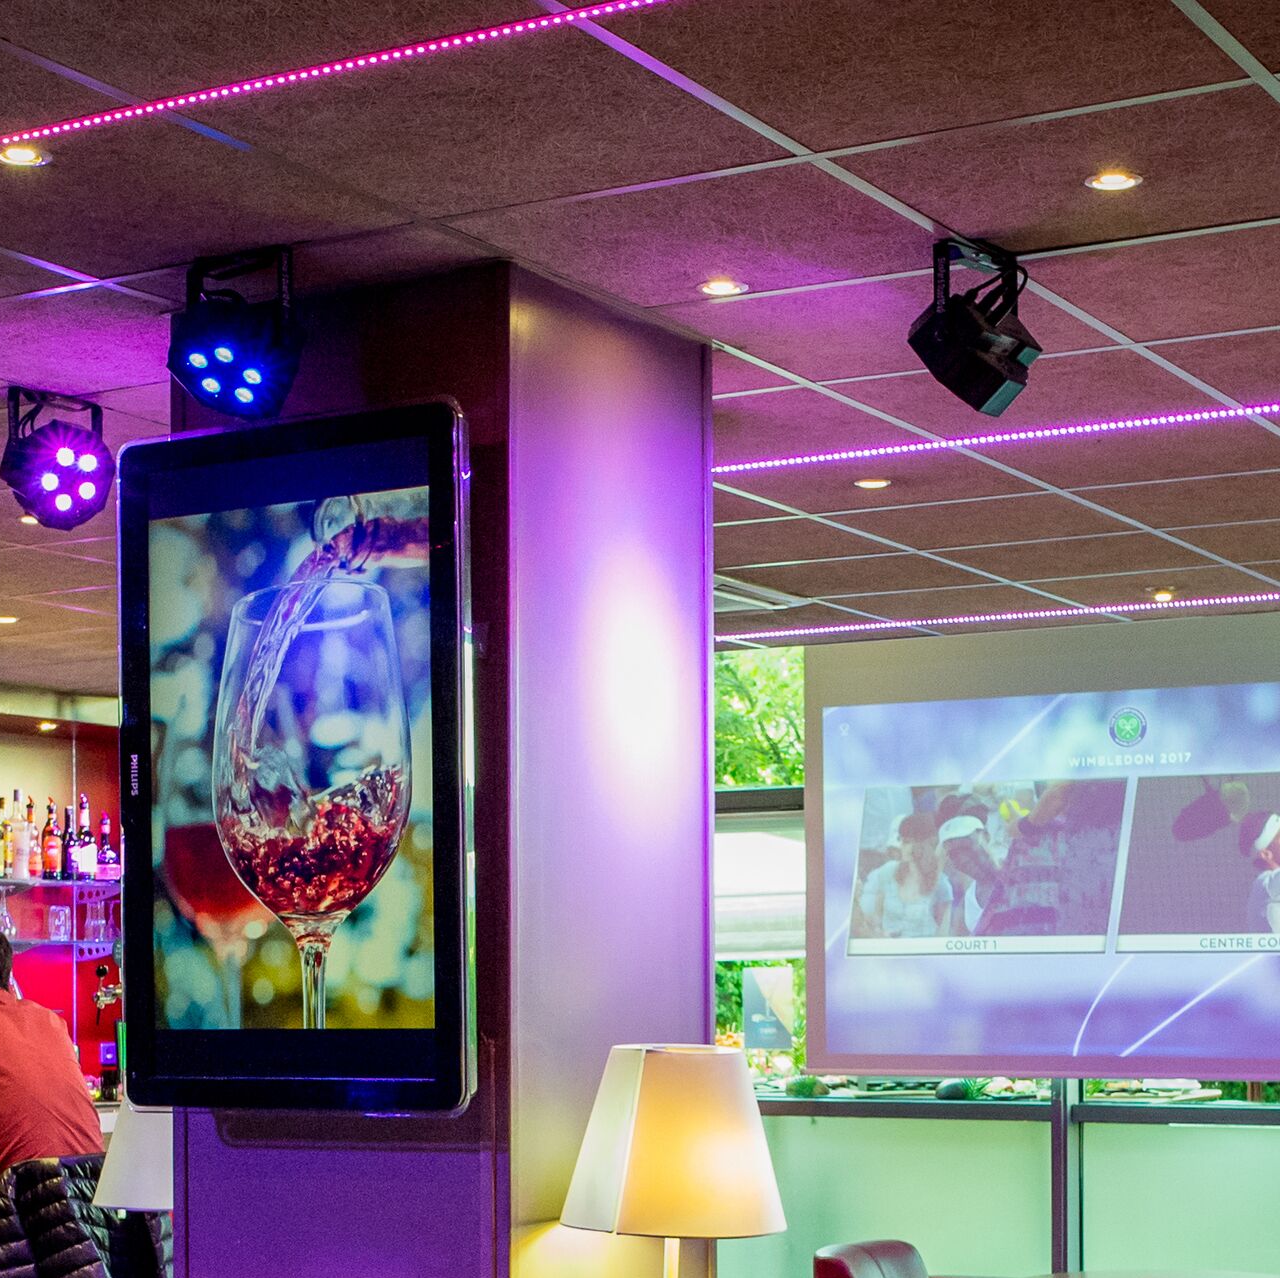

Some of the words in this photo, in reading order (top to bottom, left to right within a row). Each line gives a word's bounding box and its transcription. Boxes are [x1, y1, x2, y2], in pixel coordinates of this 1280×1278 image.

[1069, 753, 1154, 767] WIMBLEDON
[1160, 752, 1192, 764] 2017
[130, 754, 139, 796] PHILIPS
[945, 940, 988, 951] COURT
[1199, 937, 1254, 949] CENTRE
